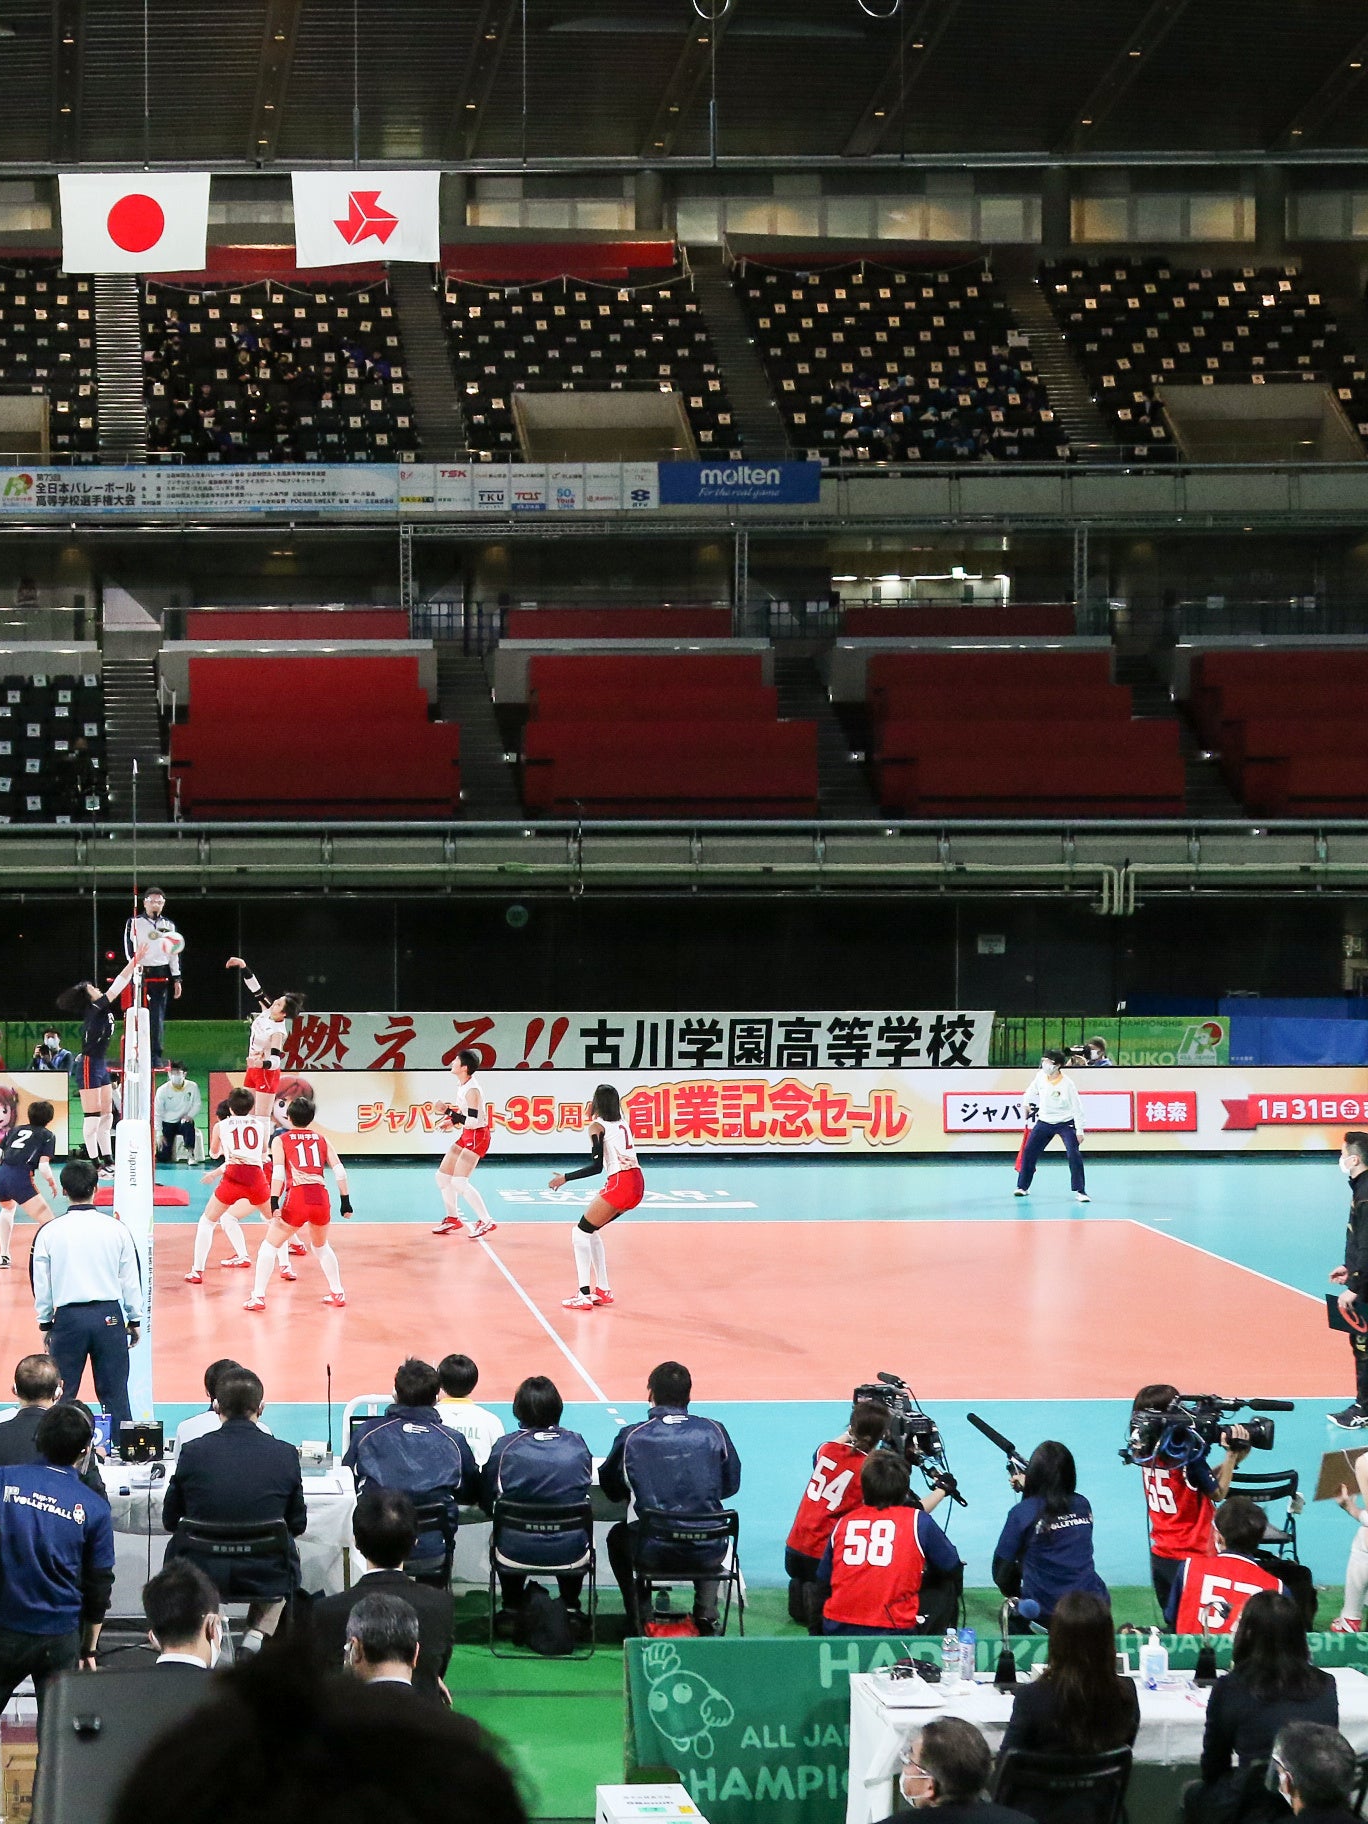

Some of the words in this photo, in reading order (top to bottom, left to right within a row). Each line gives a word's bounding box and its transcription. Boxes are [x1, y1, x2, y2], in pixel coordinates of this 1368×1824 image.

[440, 470, 468, 478] TSK
[700, 466, 780, 485] molten
[35, 482, 136, 494] 全日本バレーボール
[35, 495, 136, 506] 高等学校選手権大会
[478, 493, 504, 501] TKU
[579, 1012, 974, 1068] 古川学園高等学校
[1107, 1051, 1177, 1066] ARUKO
[623, 1081, 911, 1142] 創業記念セール
[1145, 1101, 1188, 1122] 検索
[10, 1129, 33, 1149] 2
[231, 1126, 259, 1150] 10
[294, 1141, 322, 1168] 11
[129, 1150, 139, 1188] Japanet
[806, 1455, 855, 1511] 54
[1143, 1467, 1178, 1514] 55
[12, 1494, 72, 1521] VOLLEYBALL
[842, 1519, 896, 1567] 58
[740, 1724, 797, 1750] ALL
